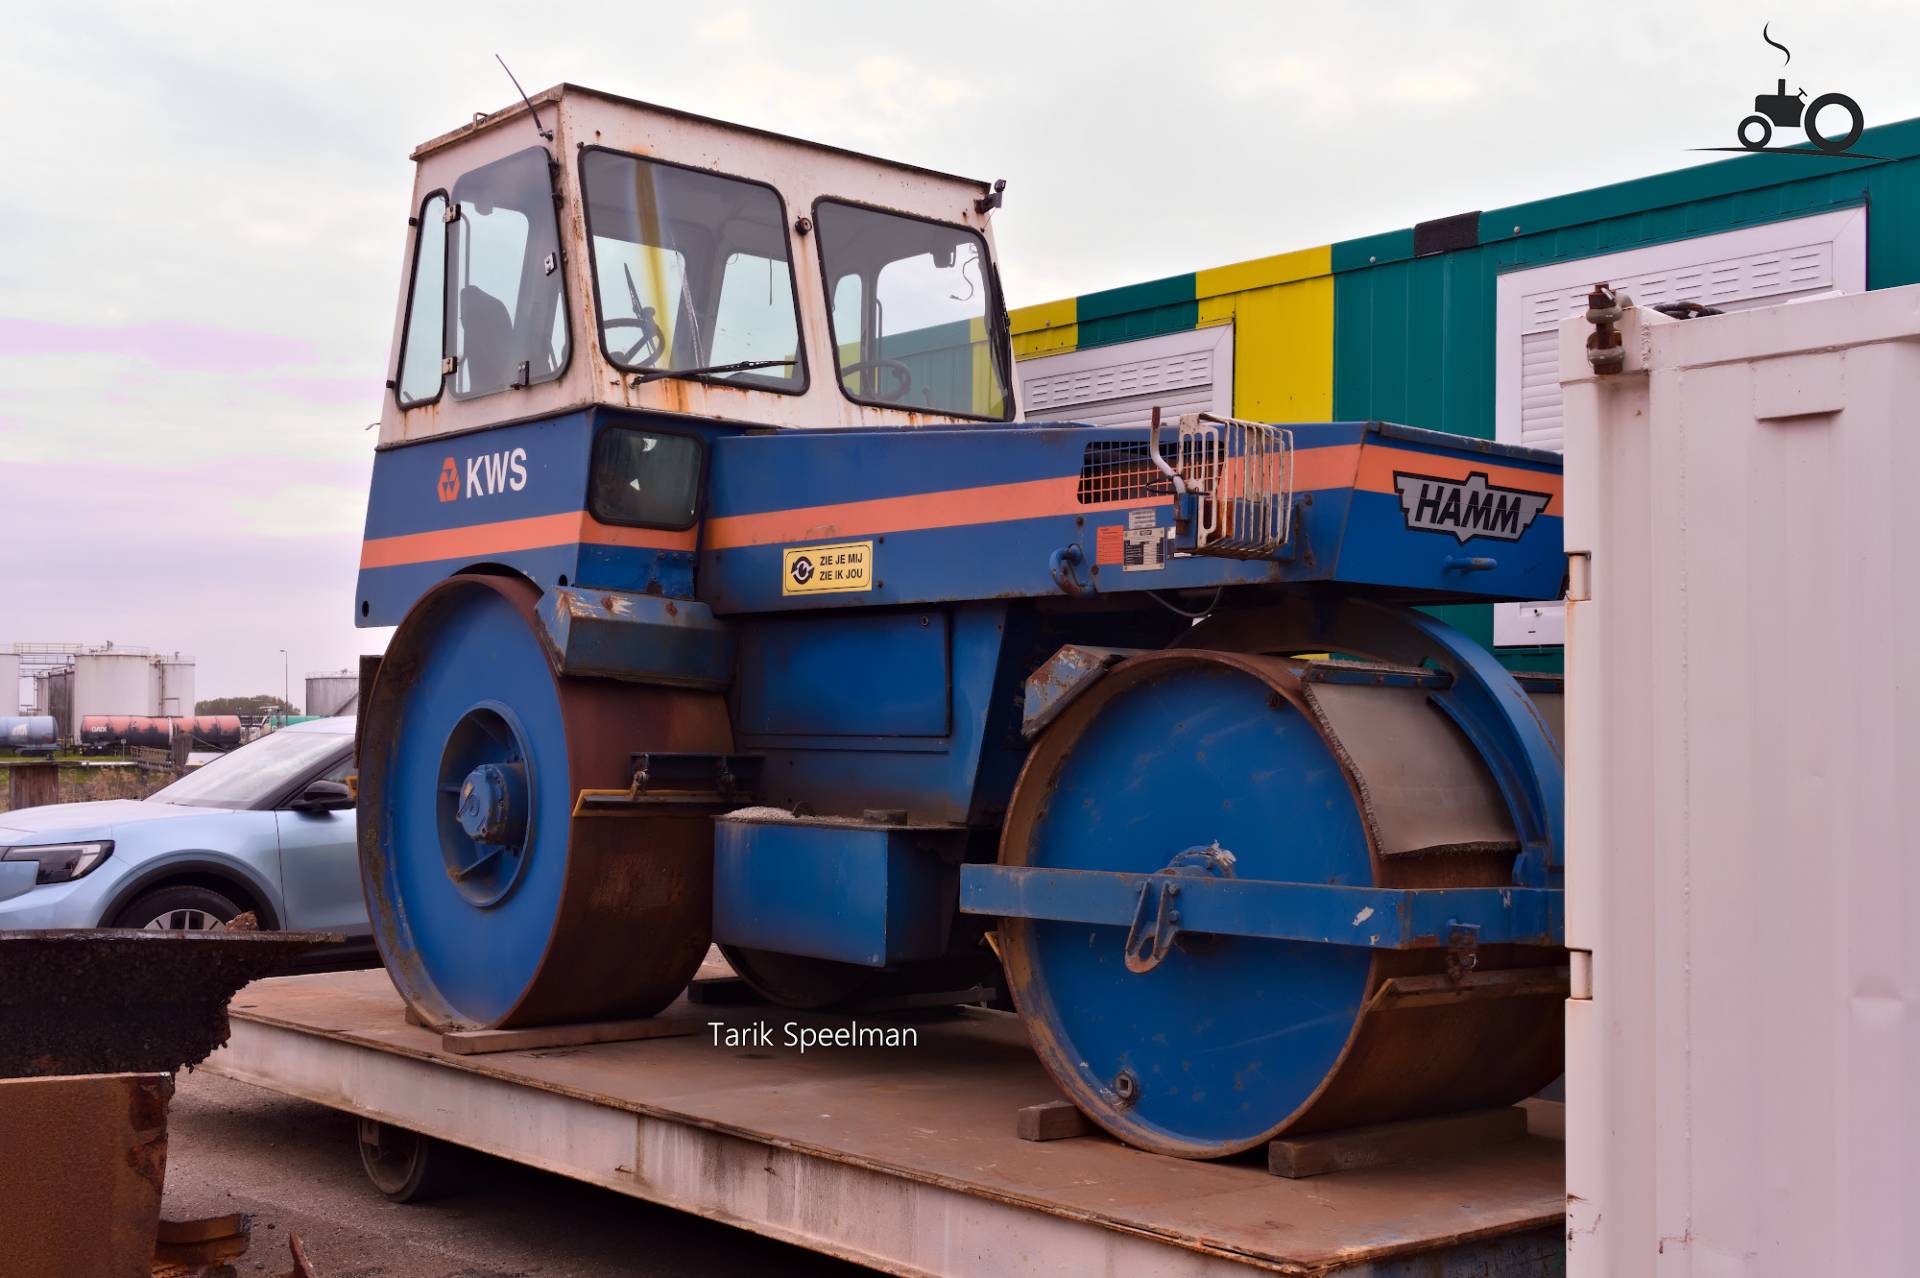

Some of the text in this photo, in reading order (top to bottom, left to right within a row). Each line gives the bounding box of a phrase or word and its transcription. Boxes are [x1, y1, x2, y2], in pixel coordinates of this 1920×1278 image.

[466, 447, 527, 499] KWS
[1414, 483, 1522, 535] HAMM
[819, 568, 863, 581] ZIE IK JOU
[820, 553, 863, 566] ZIE JE MIJ
